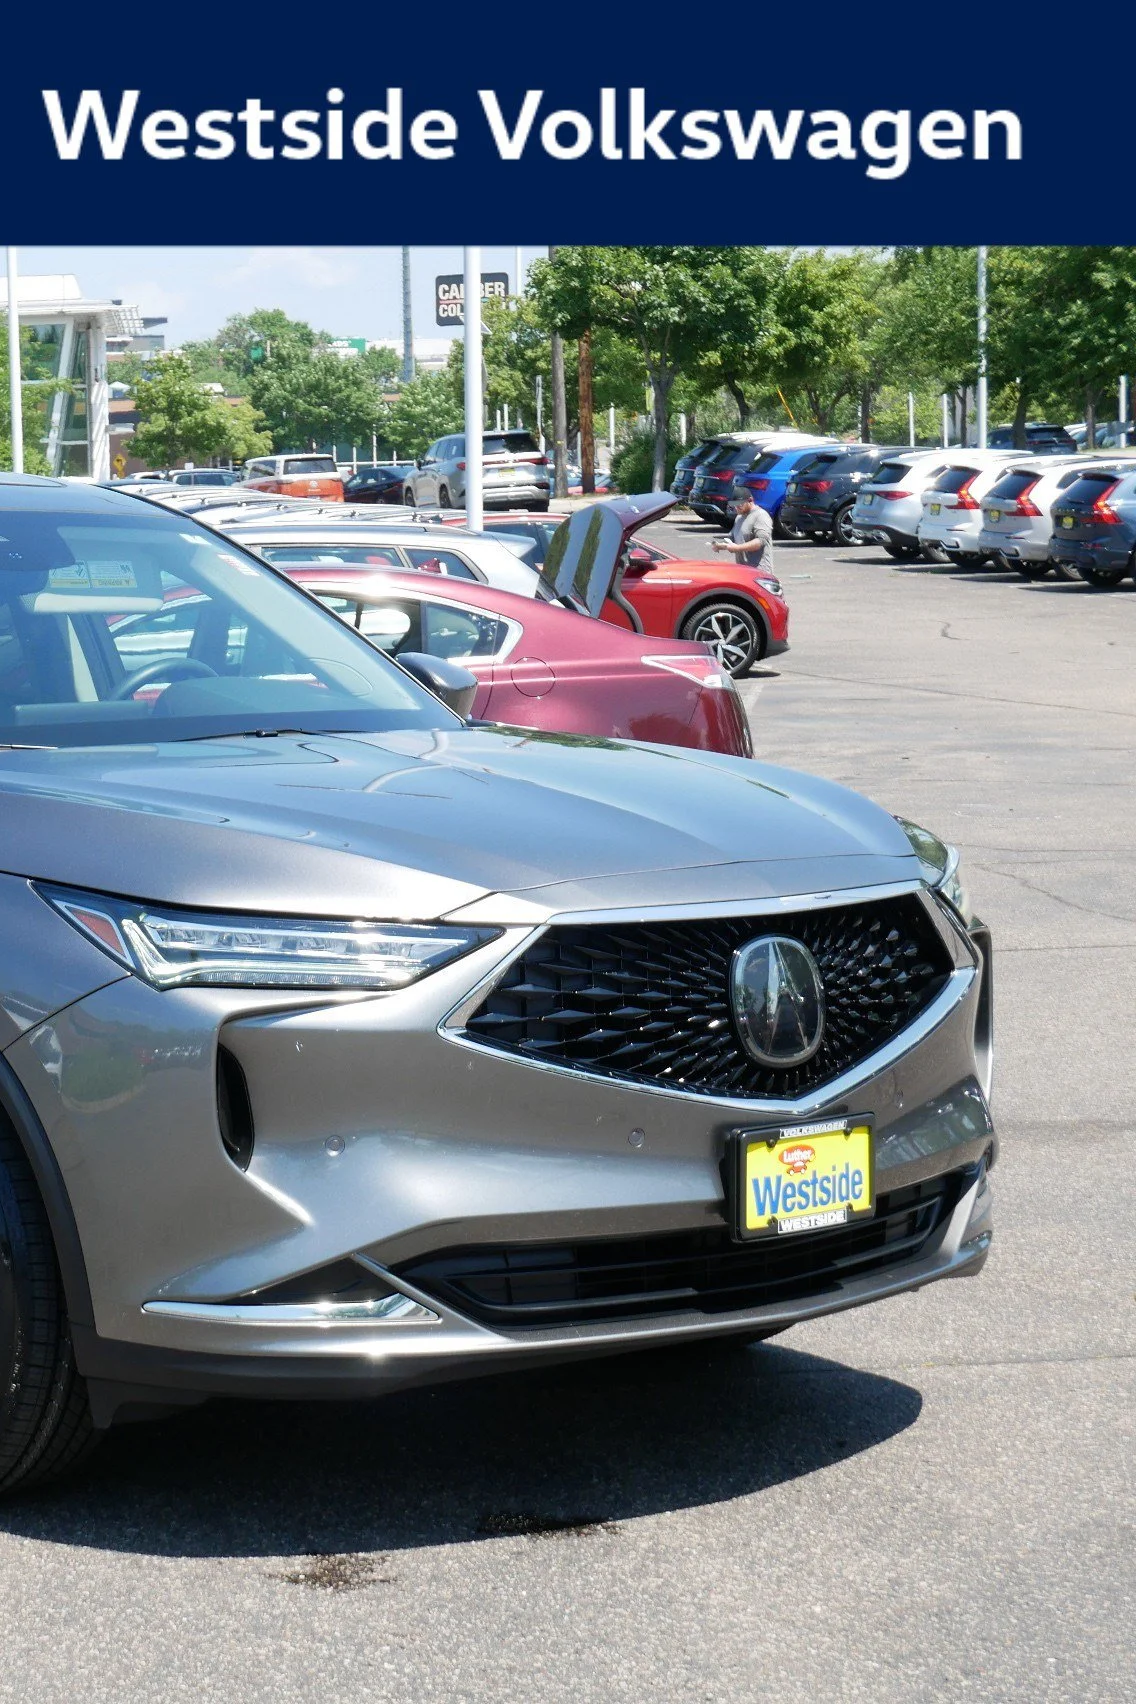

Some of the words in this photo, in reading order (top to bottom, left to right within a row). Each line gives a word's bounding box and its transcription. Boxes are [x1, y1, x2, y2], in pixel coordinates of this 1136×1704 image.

[438, 281, 506, 300] CABER
[783, 1120, 846, 1138] VOLKSWAGEN
[783, 1148, 813, 1161] Luther
[752, 1162, 863, 1217] Westside
[779, 1210, 845, 1232] WESTSIDE
